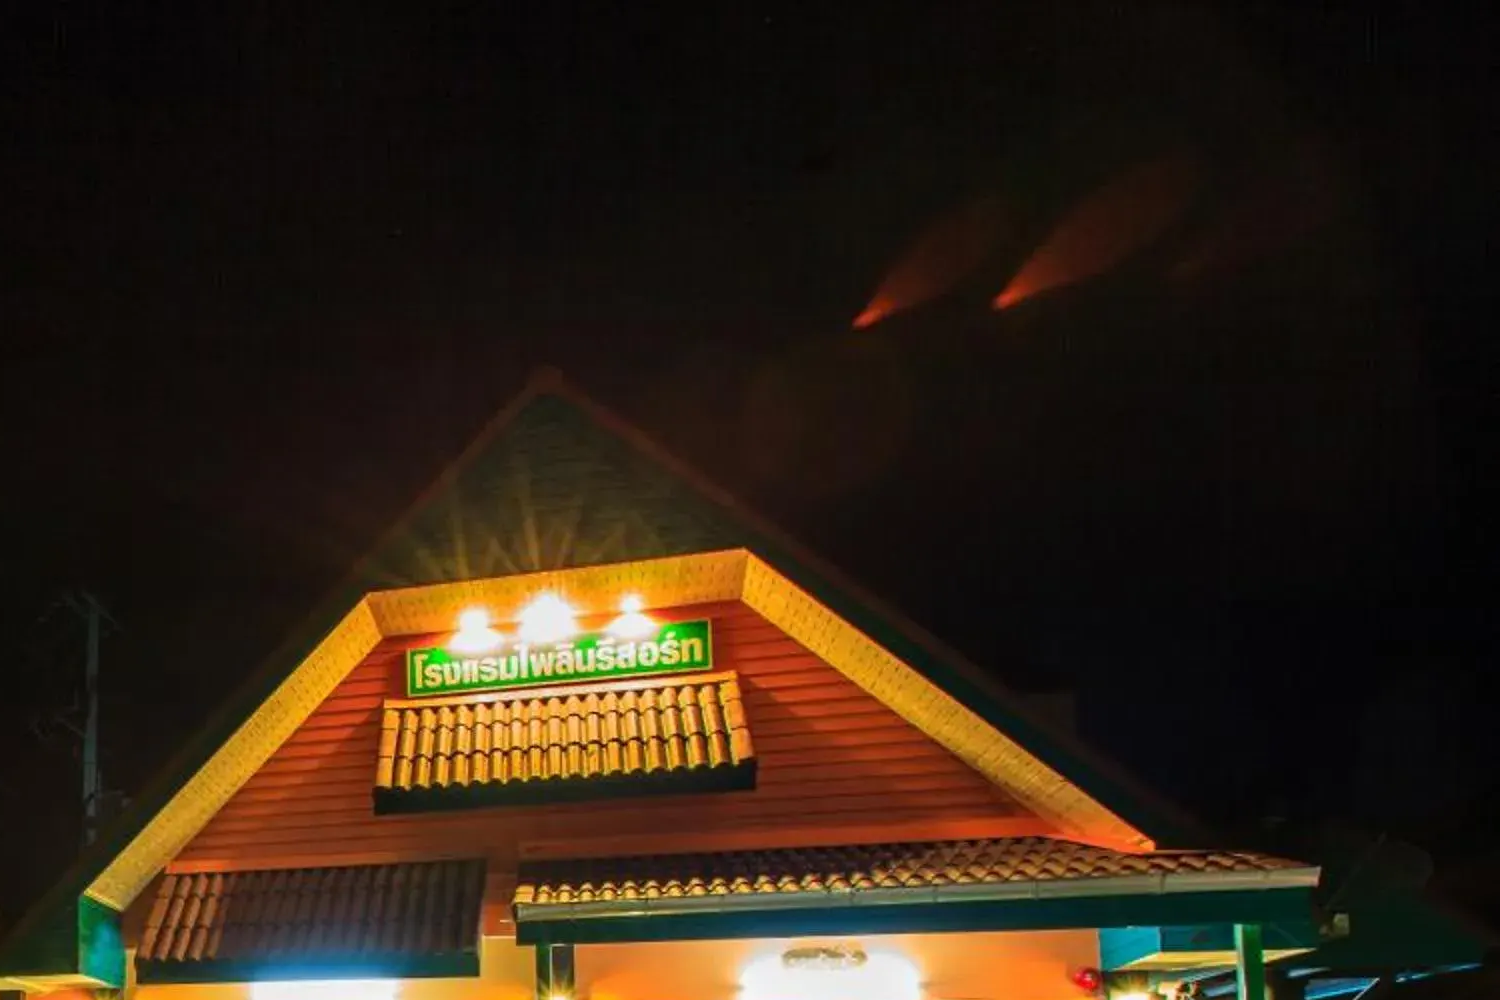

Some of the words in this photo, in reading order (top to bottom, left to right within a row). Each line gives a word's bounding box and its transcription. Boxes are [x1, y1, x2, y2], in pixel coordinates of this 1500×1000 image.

[414, 632, 702, 689] โรงแรมไพลินรีสอร์ท
